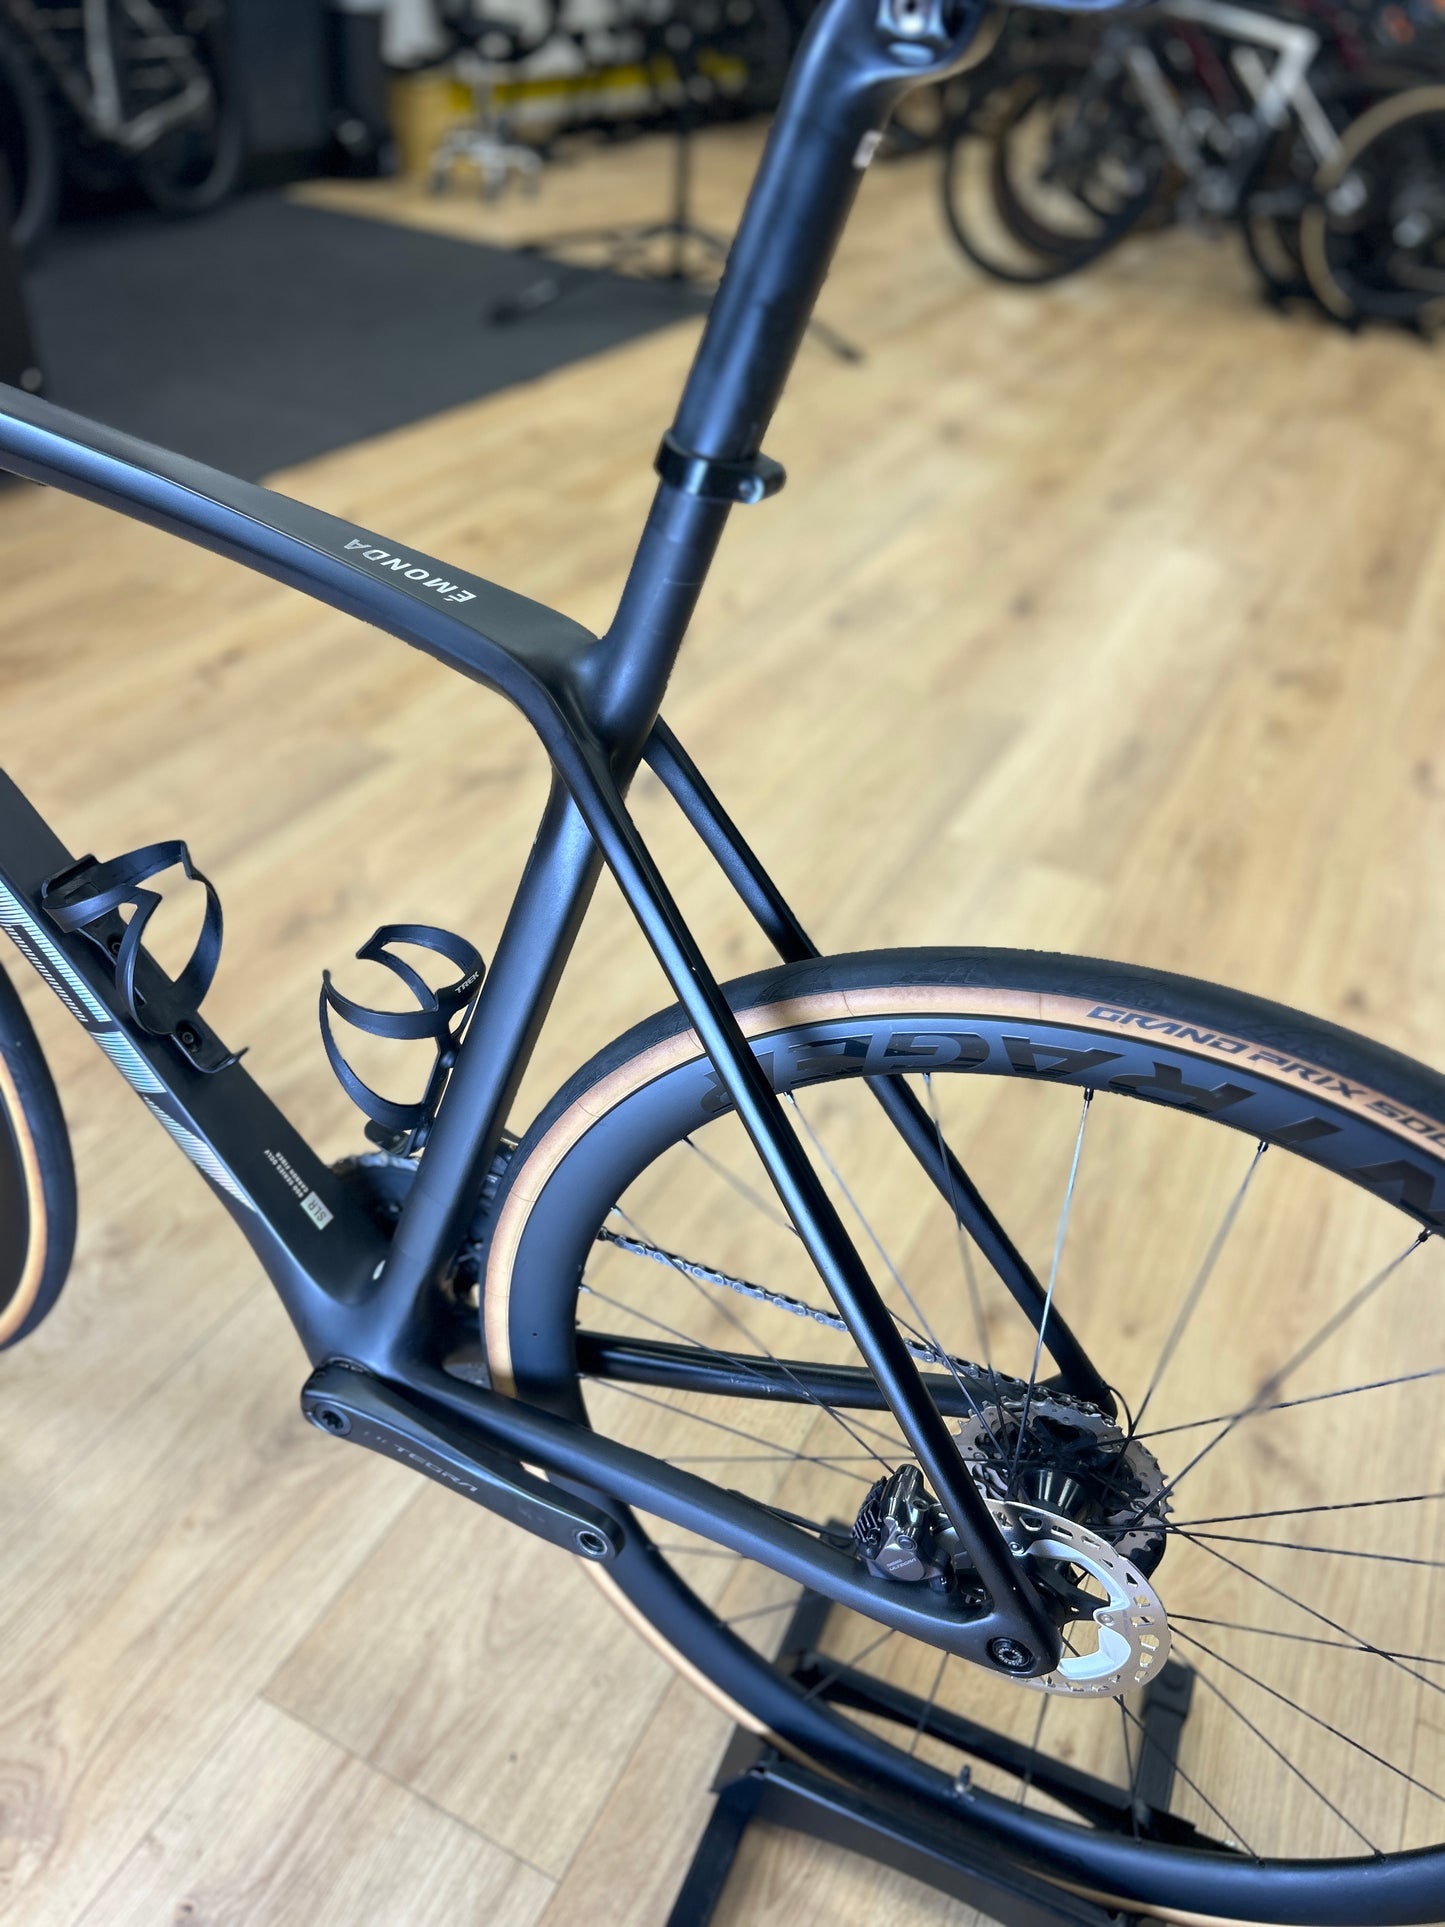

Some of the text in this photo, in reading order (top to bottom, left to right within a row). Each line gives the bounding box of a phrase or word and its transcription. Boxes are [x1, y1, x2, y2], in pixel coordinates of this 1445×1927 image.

[343, 538, 477, 603] ÉMONDA
[454, 971, 480, 994] TREK
[1086, 1005, 1250, 1054] GRAND
[1249, 1050, 1367, 1099] PRIX
[275, 1151, 309, 1193] CARBON FIBER
[276, 1164, 294, 1186] SERIES
[308, 1200, 327, 1222] SLR
